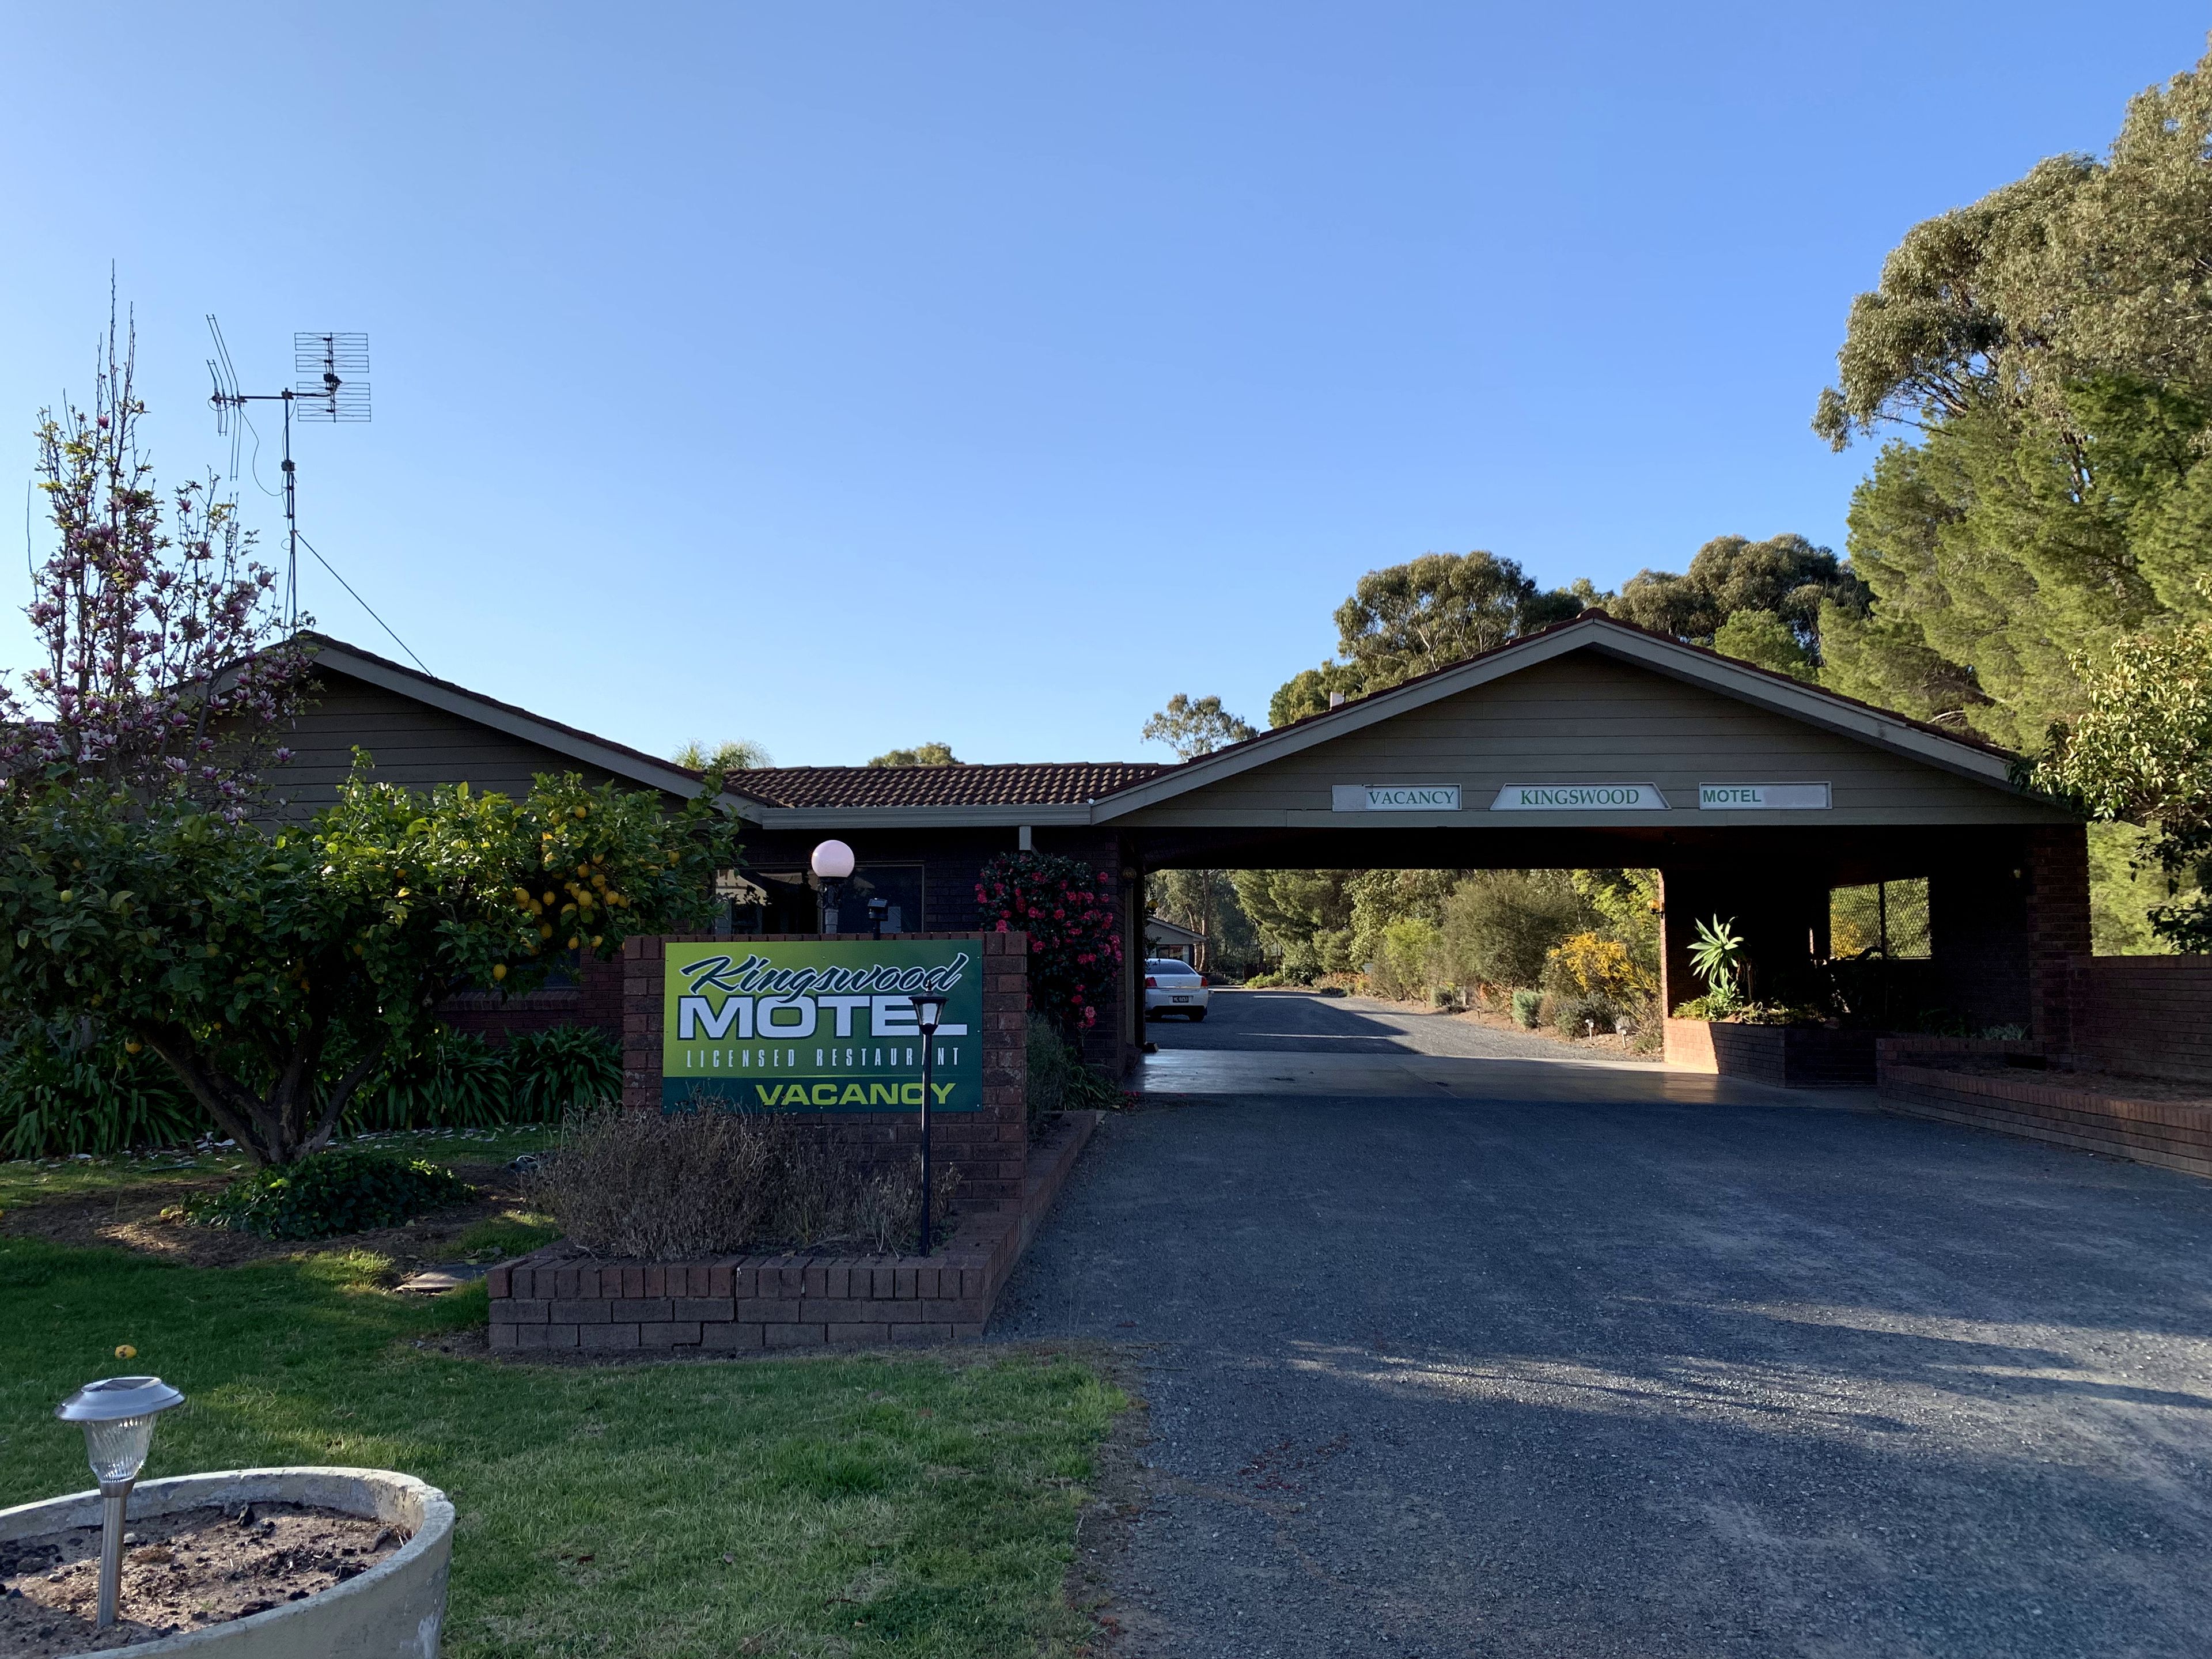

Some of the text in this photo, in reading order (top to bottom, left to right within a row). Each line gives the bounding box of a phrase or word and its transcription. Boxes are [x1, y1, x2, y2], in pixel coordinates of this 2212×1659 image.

[1368, 791, 1454, 804] VACANCY
[1520, 789, 1639, 805] KINGSWOOD
[1703, 789, 1762, 802] MOTEL
[679, 952, 969, 1003] Kingswood
[687, 1047, 959, 1067] LICENSED RESTAURNT
[755, 1082, 956, 1105] VACANCY
